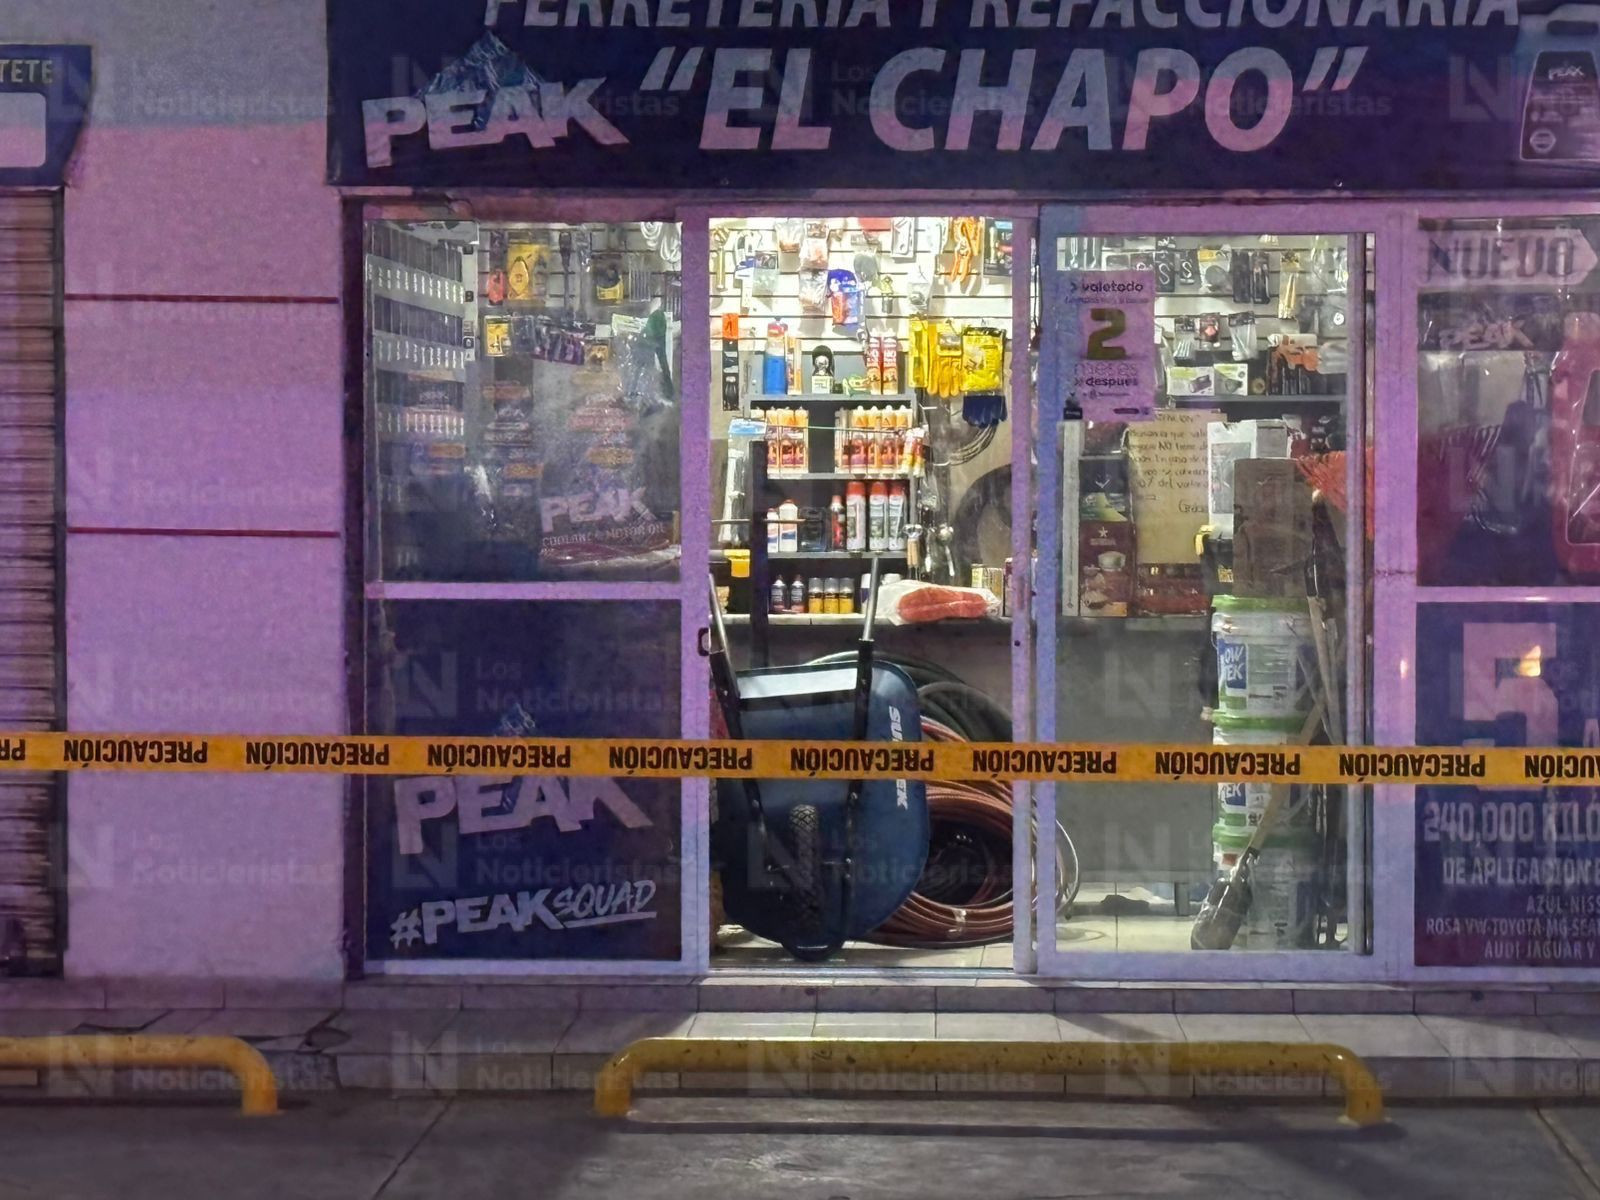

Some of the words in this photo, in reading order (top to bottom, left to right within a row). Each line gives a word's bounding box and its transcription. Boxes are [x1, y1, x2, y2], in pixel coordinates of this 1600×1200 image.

[361, 76, 630, 168] PEAK
[1086, 307, 1127, 360] 2
[540, 487, 657, 533] PEAK
[1463, 622, 1559, 791] 5
[63, 739, 207, 767] PRECAUCIÓN
[246, 741, 389, 769] PRECAUCIÓN
[428, 743, 570, 771] PRECAUCIÓN
[609, 745, 752, 773] PRECAUCIÓN
[791, 746, 934, 774] PRECAUCIÓN
[973, 748, 1116, 776] PRECAUCIÓN
[1155, 750, 1300, 778] PRECAUCIÓN
[1339, 752, 1485, 780] PRECAUCIÓN
[393, 775, 653, 855] PEAK
[1424, 802, 1534, 847] 240,000
[1443, 857, 1466, 885] DE
